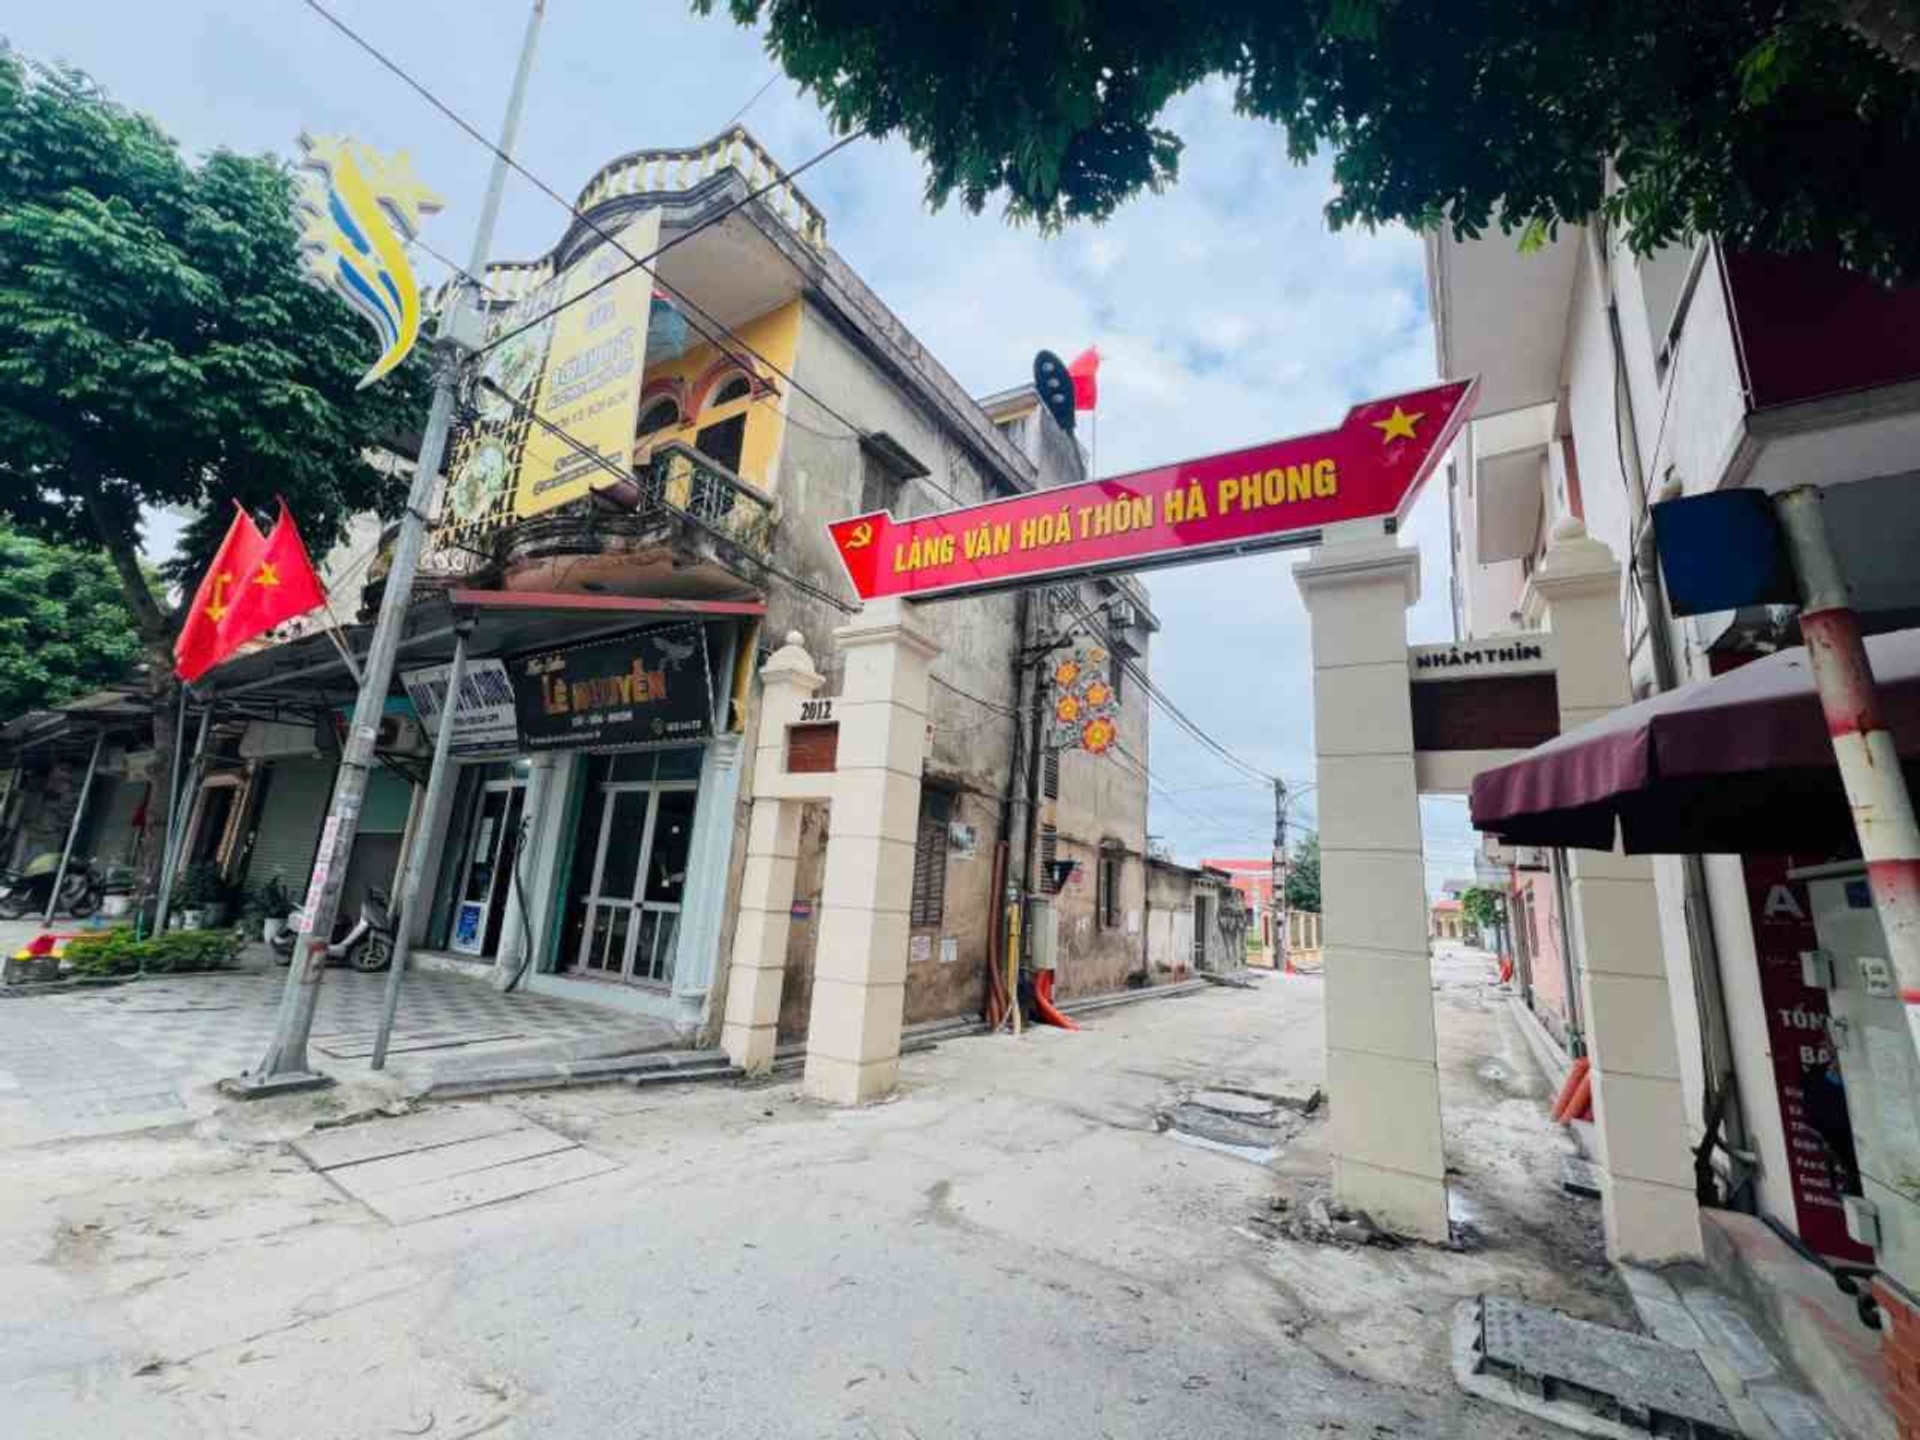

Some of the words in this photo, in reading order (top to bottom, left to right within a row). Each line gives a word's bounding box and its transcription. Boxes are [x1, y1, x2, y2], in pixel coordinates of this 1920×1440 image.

[893, 532, 957, 572] LÀNG
[963, 520, 1012, 560] VĂN
[1019, 504, 1073, 550] HOÁ
[1077, 491, 1154, 540] THÔN
[1163, 477, 1209, 525] HÀ
[1217, 457, 1339, 516] PHONG
[799, 699, 832, 721] 2012
